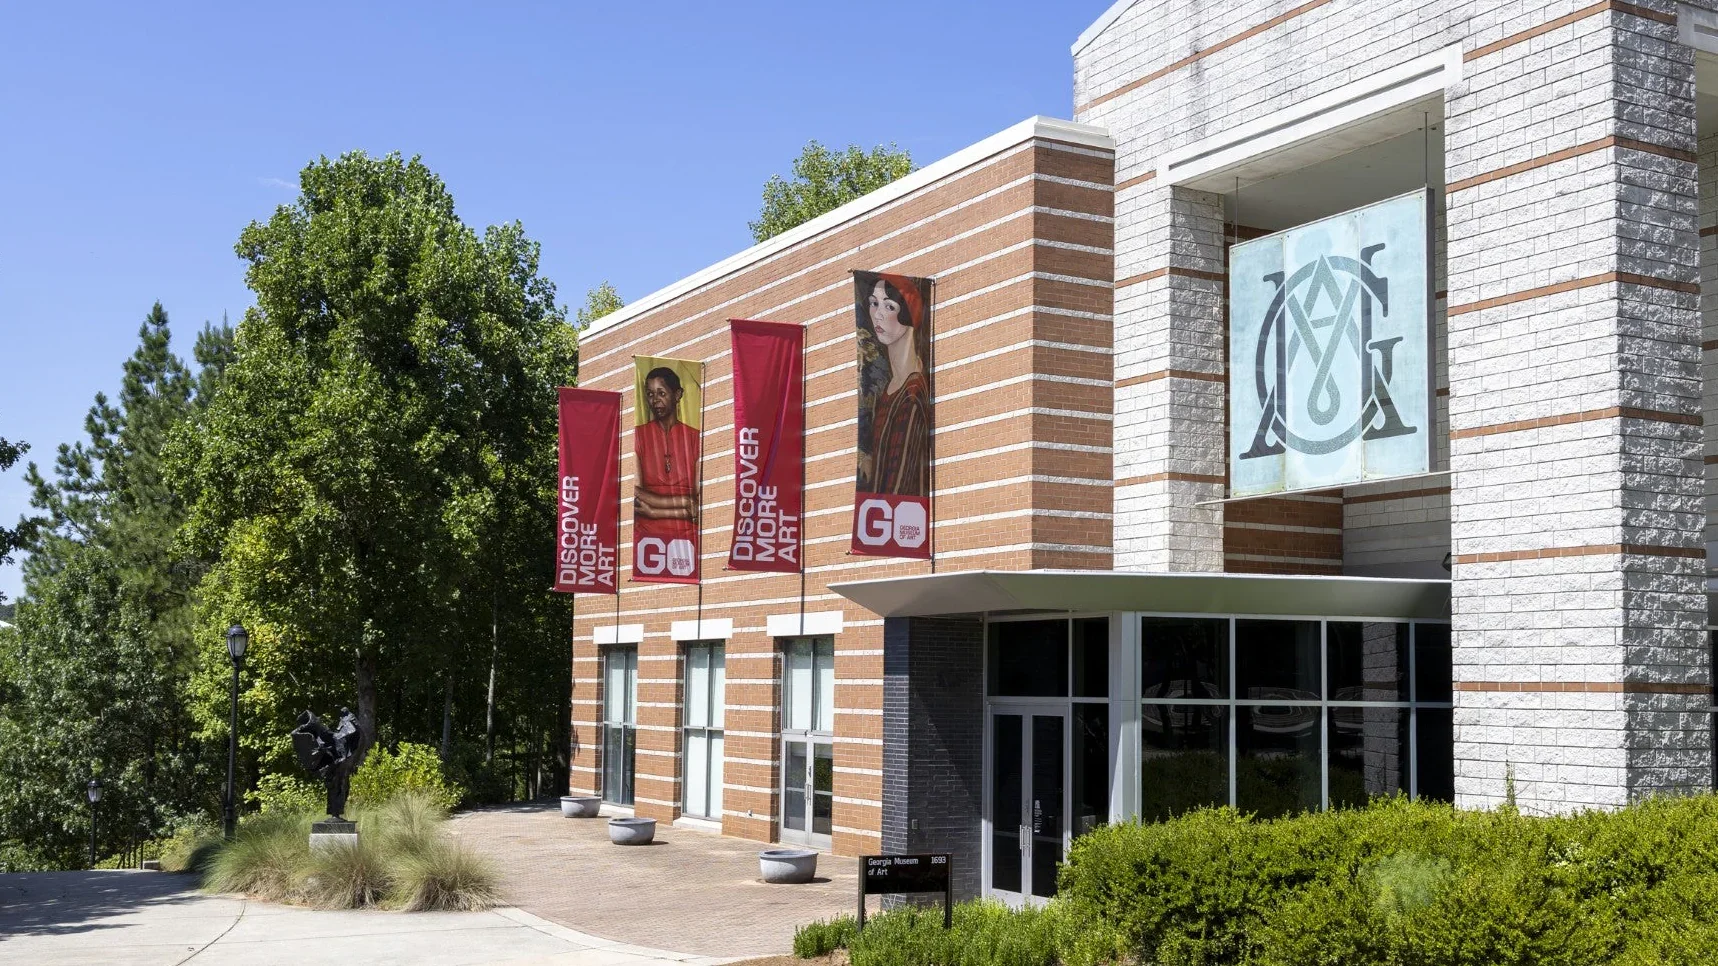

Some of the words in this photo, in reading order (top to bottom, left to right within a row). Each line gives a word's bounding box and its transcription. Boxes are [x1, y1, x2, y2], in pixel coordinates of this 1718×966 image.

[733, 427, 759, 561] DISCOVER
[559, 475, 579, 585] DISCOVER
[755, 485, 777, 562] MORE
[777, 509, 798, 564] ART
[578, 522, 598, 586] MORE
[597, 542, 615, 587] ART
[868, 858, 892, 867] Georgia
[894, 857, 919, 865] Museum
[868, 868, 875, 876] of
[877, 868, 888, 876] Art
[931, 856, 947, 864] 1693
